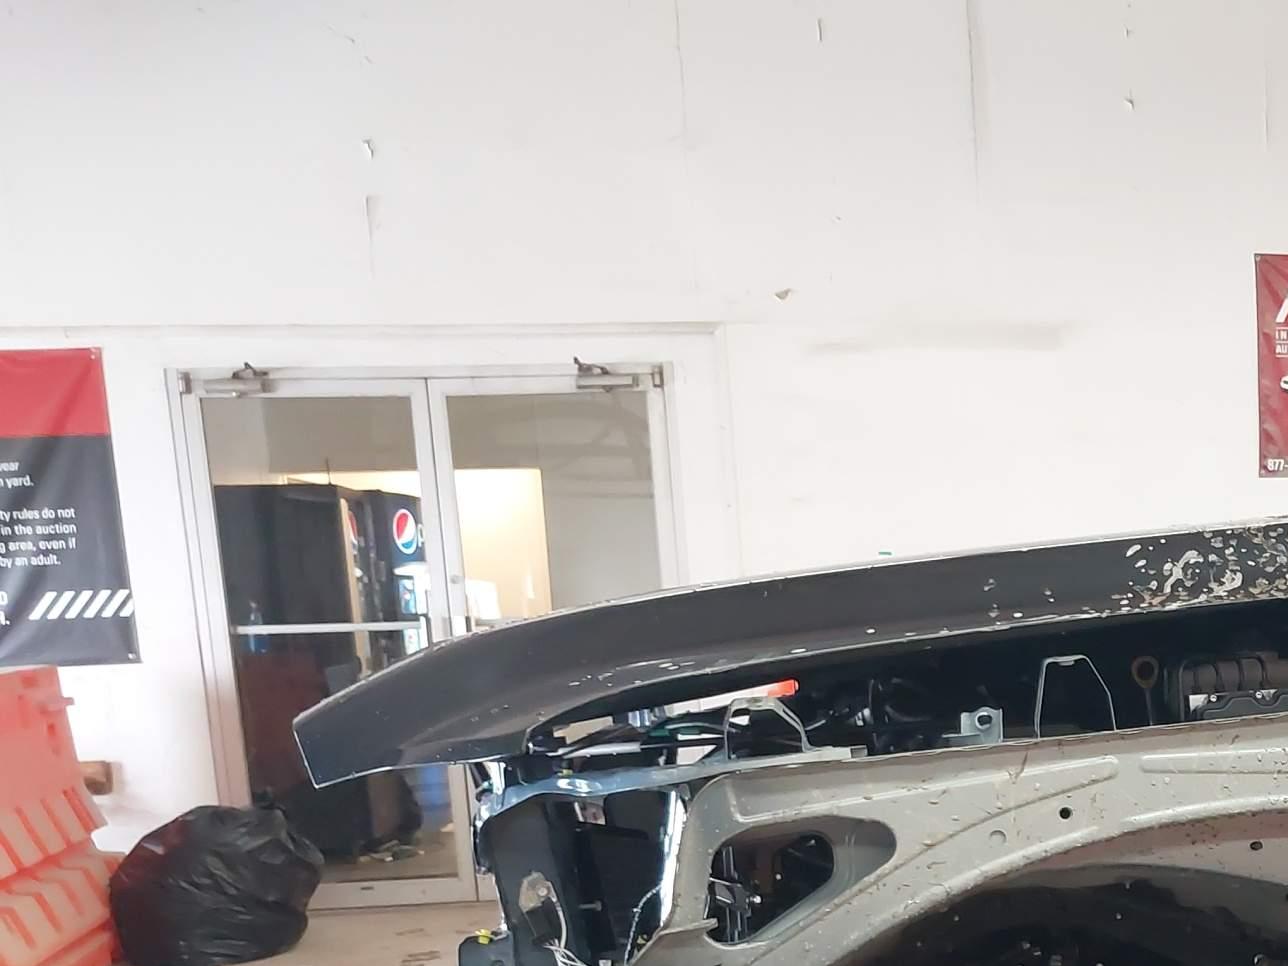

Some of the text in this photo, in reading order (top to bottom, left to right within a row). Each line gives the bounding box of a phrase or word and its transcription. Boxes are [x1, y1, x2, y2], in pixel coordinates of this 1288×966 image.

[5, 474, 34, 488] yard.
[12, 507, 40, 519] rules
[41, 507, 56, 519] do
[57, 507, 76, 518] not
[0, 522, 77, 536] in the auction
[8, 541, 36, 551] area,
[39, 540, 66, 550] even
[68, 537, 76, 549] if
[14, 556, 29, 566] an
[30, 553, 61, 566] adult.
